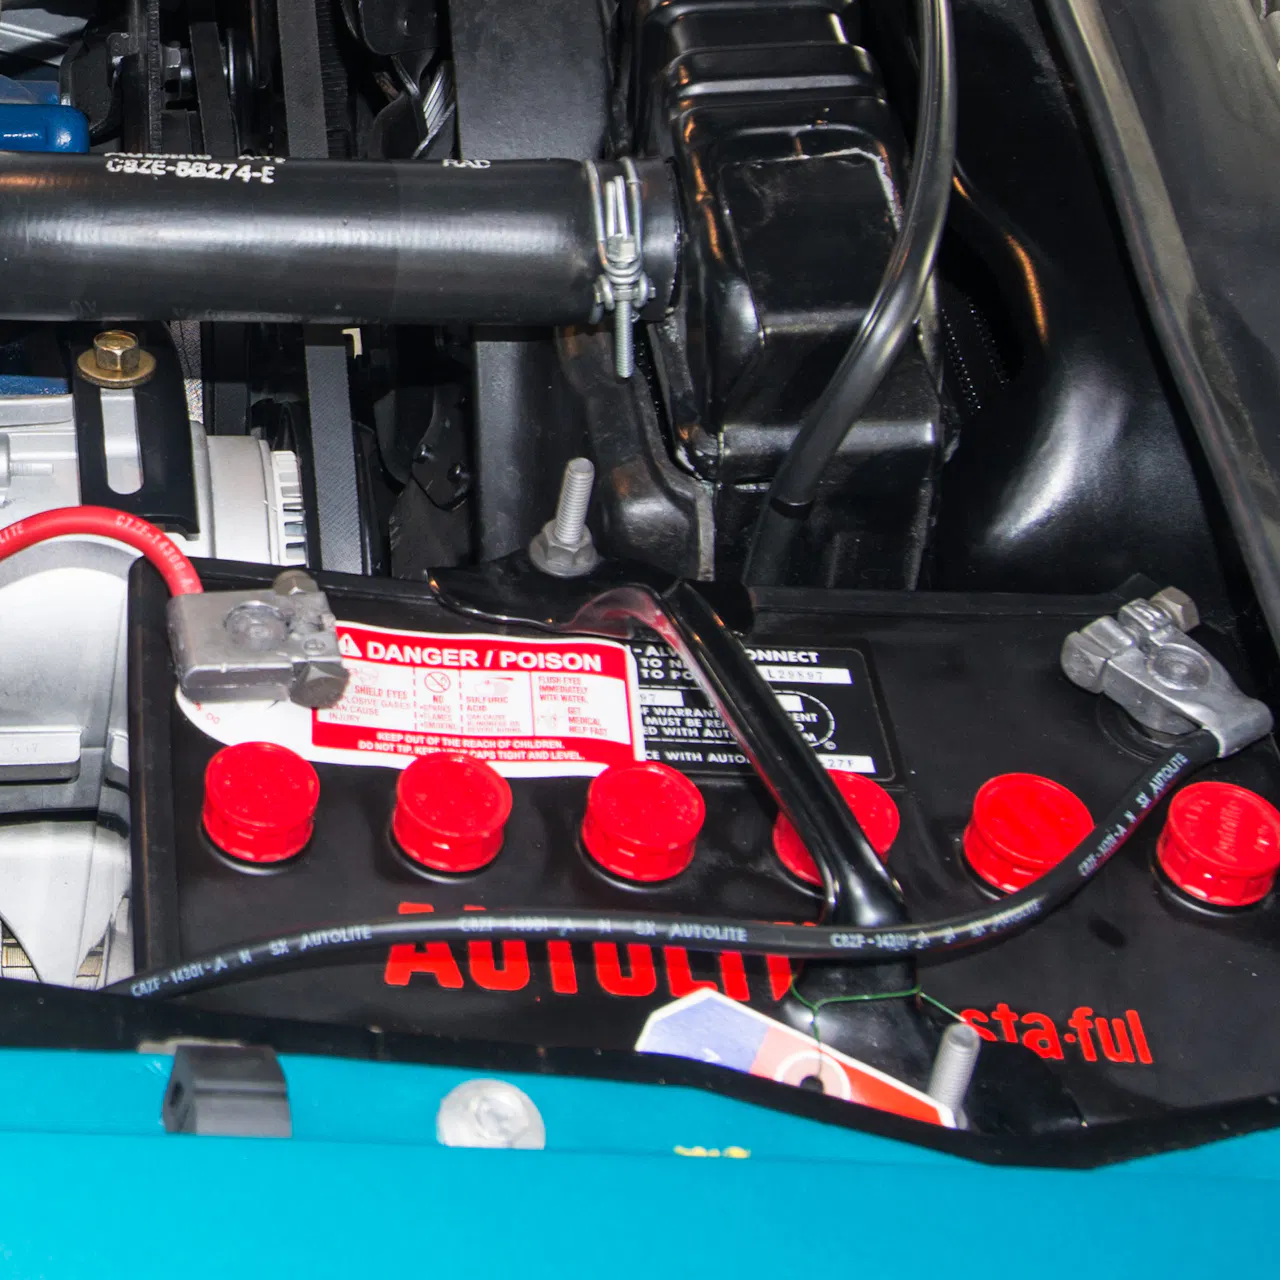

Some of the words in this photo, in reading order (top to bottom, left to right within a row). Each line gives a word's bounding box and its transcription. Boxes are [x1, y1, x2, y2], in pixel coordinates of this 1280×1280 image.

[366, 640, 480, 668] DANGER
[499, 649, 603, 672] POISON
[743, 649, 820, 663] ONNECT
[639, 668, 665, 680] TO
[563, 677, 581, 686] EYES
[354, 685, 383, 698] SHIELD
[386, 690, 409, 700] EYES
[539, 694, 560, 702] WITH
[643, 716, 682, 727] MUST
[685, 718, 702, 728] BE
[661, 727, 699, 737] WITH
[377, 731, 404, 743] KEEP
[405, 733, 426, 745] OUT
[427, 735, 441, 746] OF
[442, 736, 461, 748] THE
[462, 738, 497, 749] REACH
[498, 739, 511, 749] OF
[512, 739, 566, 749] CHILDREN.
[357, 739, 374, 750] DO
[375, 741, 397, 752] NOT
[497, 750, 526, 760] TIGHT
[527, 750, 550, 760] AND
[551, 751, 586, 761] LEVEL.
[664, 751, 703, 762] WITH
[1149, 752, 1189, 797] AUTOLITE
[667, 923, 748, 942] AUTOLITE
[268, 938, 291, 956] SX
[299, 924, 373, 951] AUTOLITE
